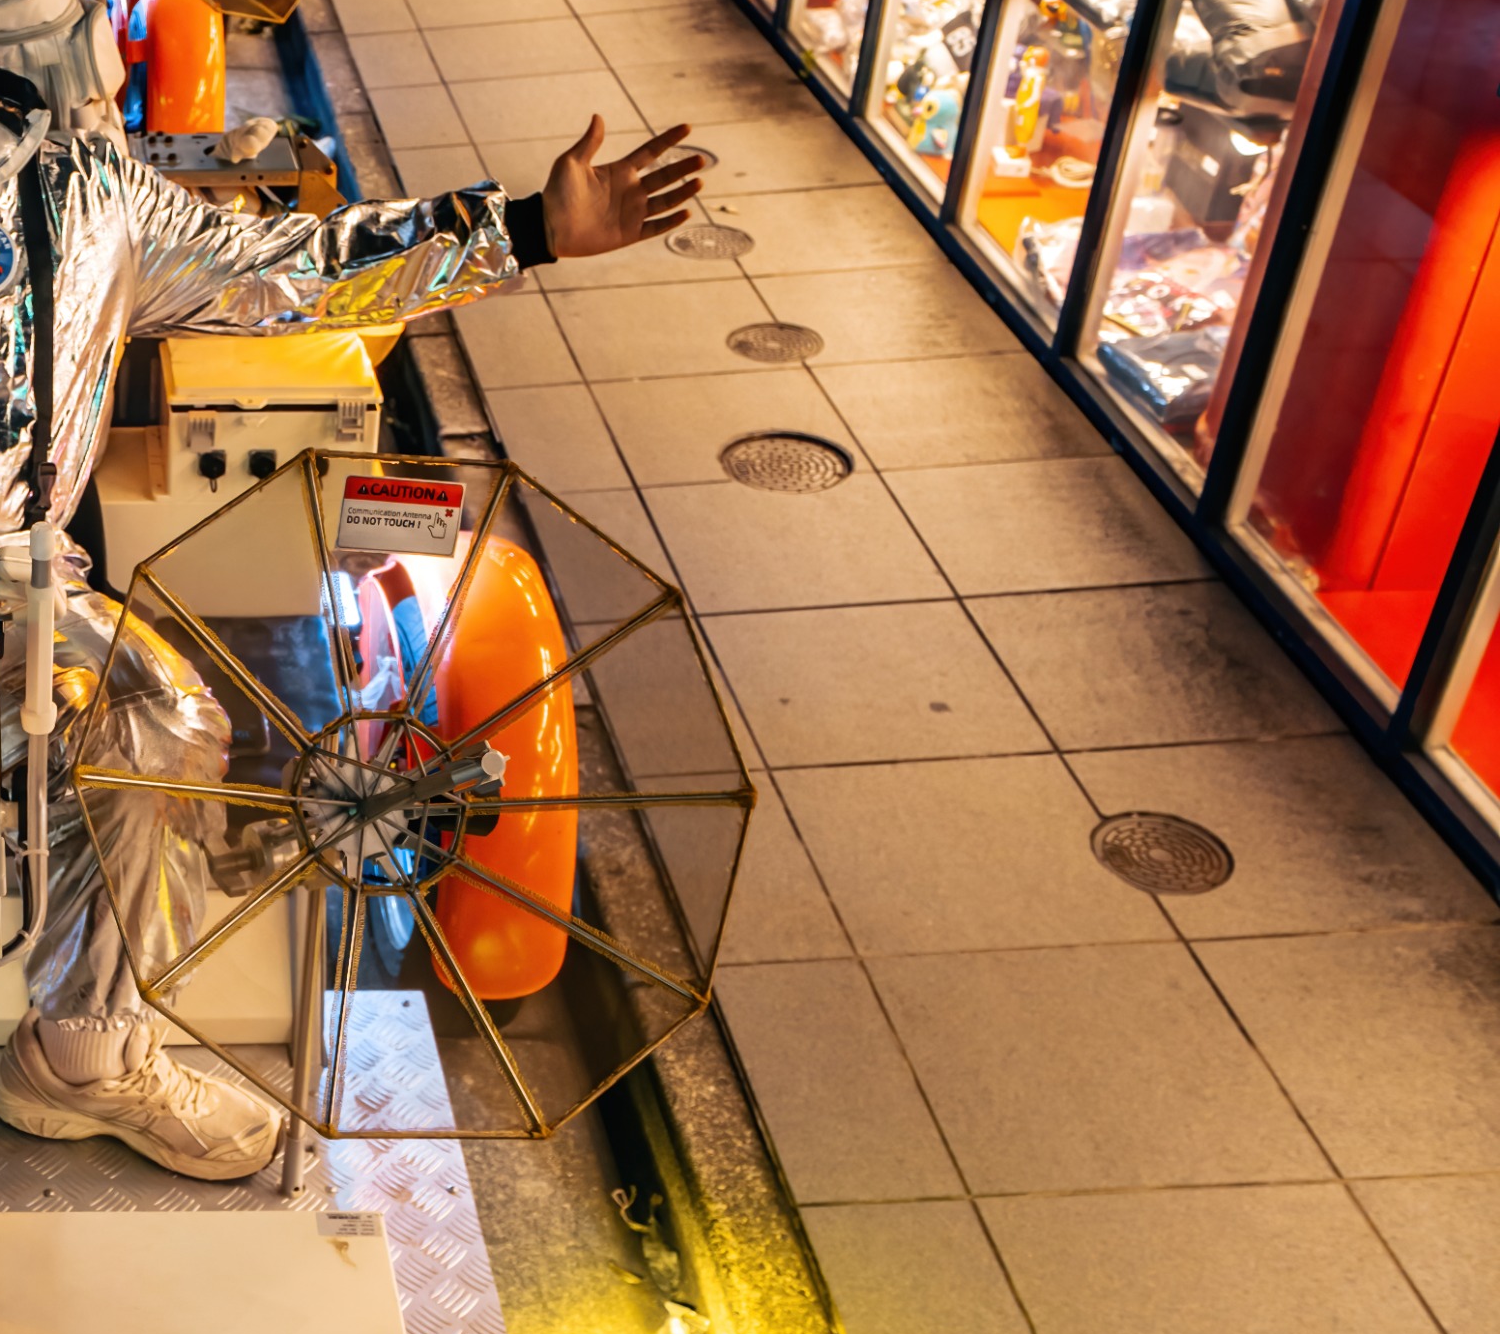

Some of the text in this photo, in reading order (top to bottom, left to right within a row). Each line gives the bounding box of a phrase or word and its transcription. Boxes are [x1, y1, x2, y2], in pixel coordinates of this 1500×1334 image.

[370, 483, 435, 500] CAUTION
[347, 507, 432, 520] Communication Antenna
[346, 515, 360, 524] DO
[362, 516, 382, 526] NOT
[384, 518, 415, 528] TOUCH
